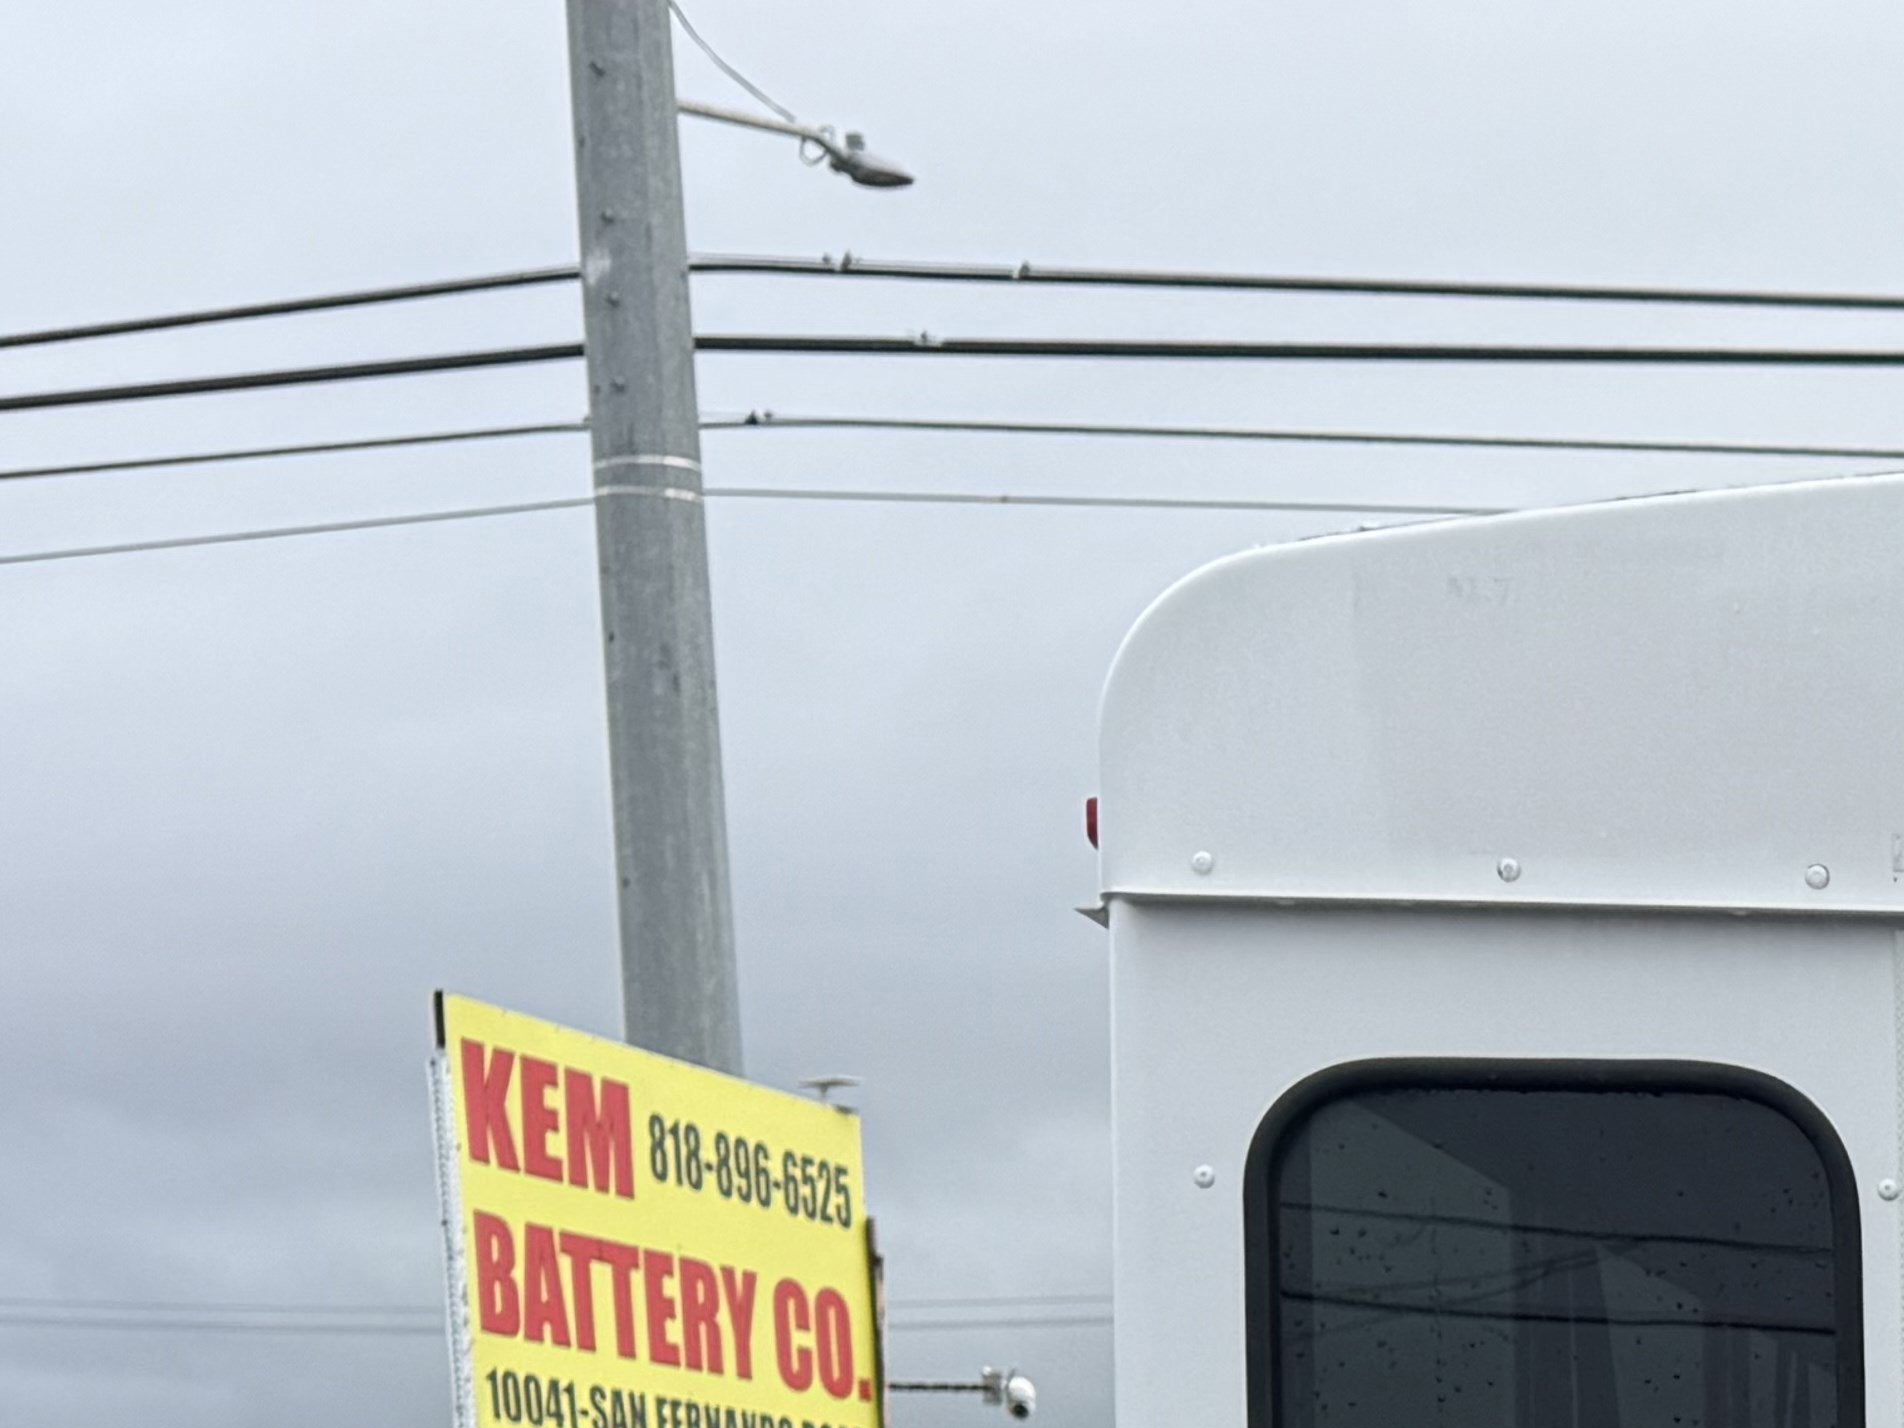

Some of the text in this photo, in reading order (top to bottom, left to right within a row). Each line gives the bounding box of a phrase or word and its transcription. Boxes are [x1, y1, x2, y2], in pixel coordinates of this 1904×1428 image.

[460, 1036, 635, 1200] KEM
[648, 1112, 852, 1230] 818-896-6525
[473, 1209, 872, 1401] BATTERY CO.
